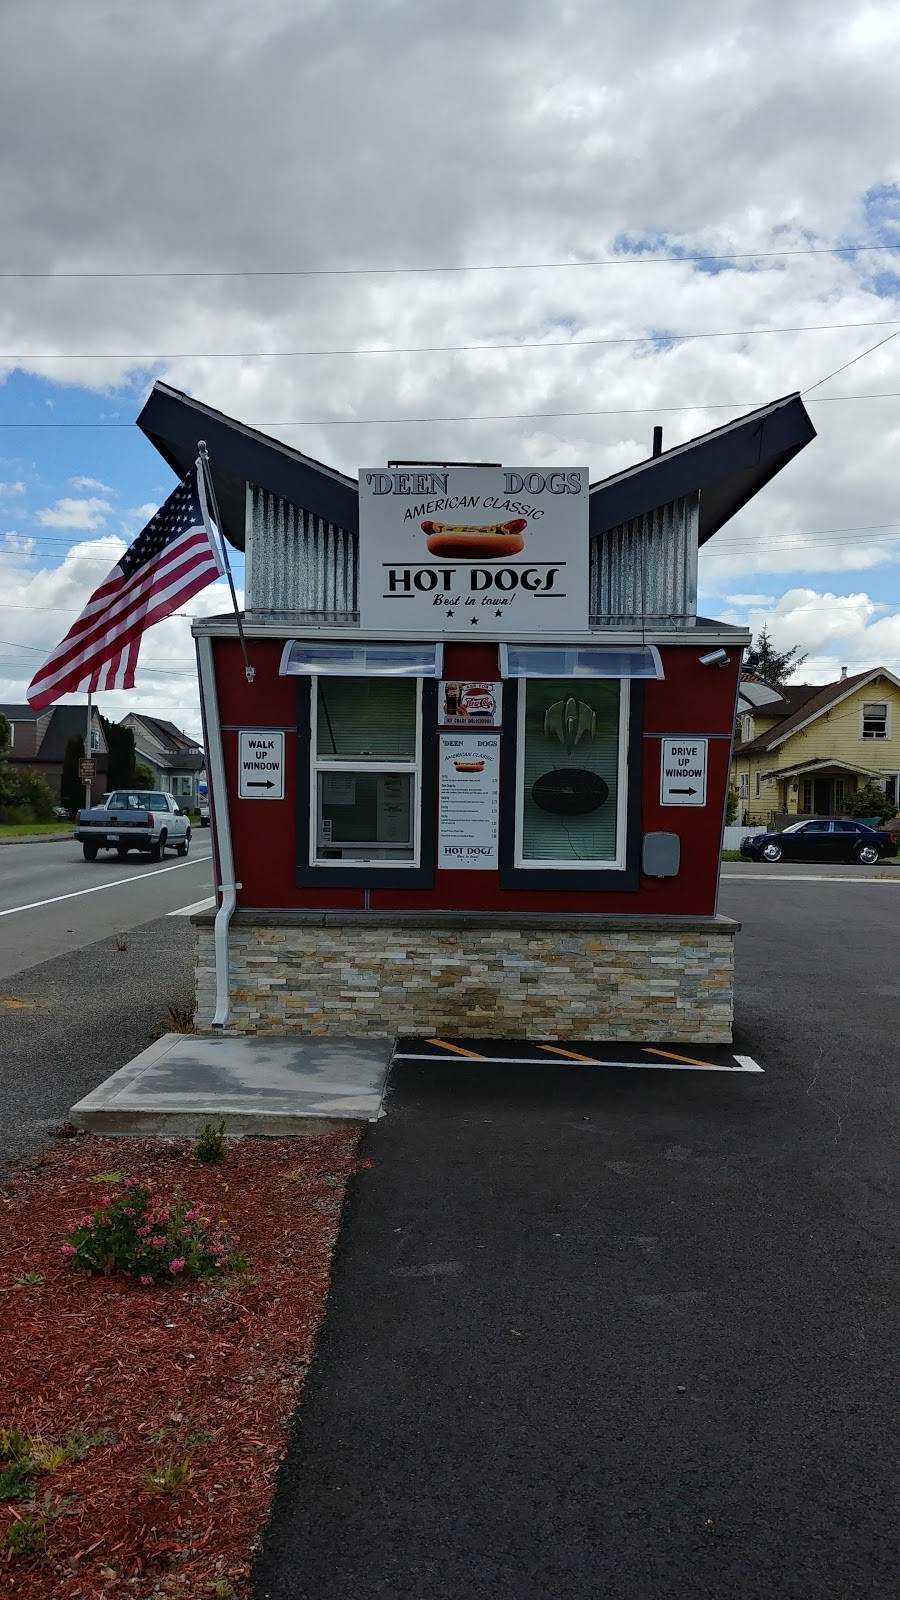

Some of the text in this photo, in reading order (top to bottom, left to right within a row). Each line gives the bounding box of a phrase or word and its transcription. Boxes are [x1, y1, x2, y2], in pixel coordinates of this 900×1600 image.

[504, 472, 582, 495] DOGS
[403, 496, 545, 522] AMERICAN CLASSIC
[388, 568, 560, 591] HOT DOGS
[432, 593, 516, 606] Best in town!
[248, 740, 275, 749] WALK
[255, 751, 268, 760] UP
[671, 747, 698, 756] DRIVE
[243, 762, 280, 770] WINDOW
[678, 758, 690, 767] UP
[665, 769, 702, 777] WINDOW
